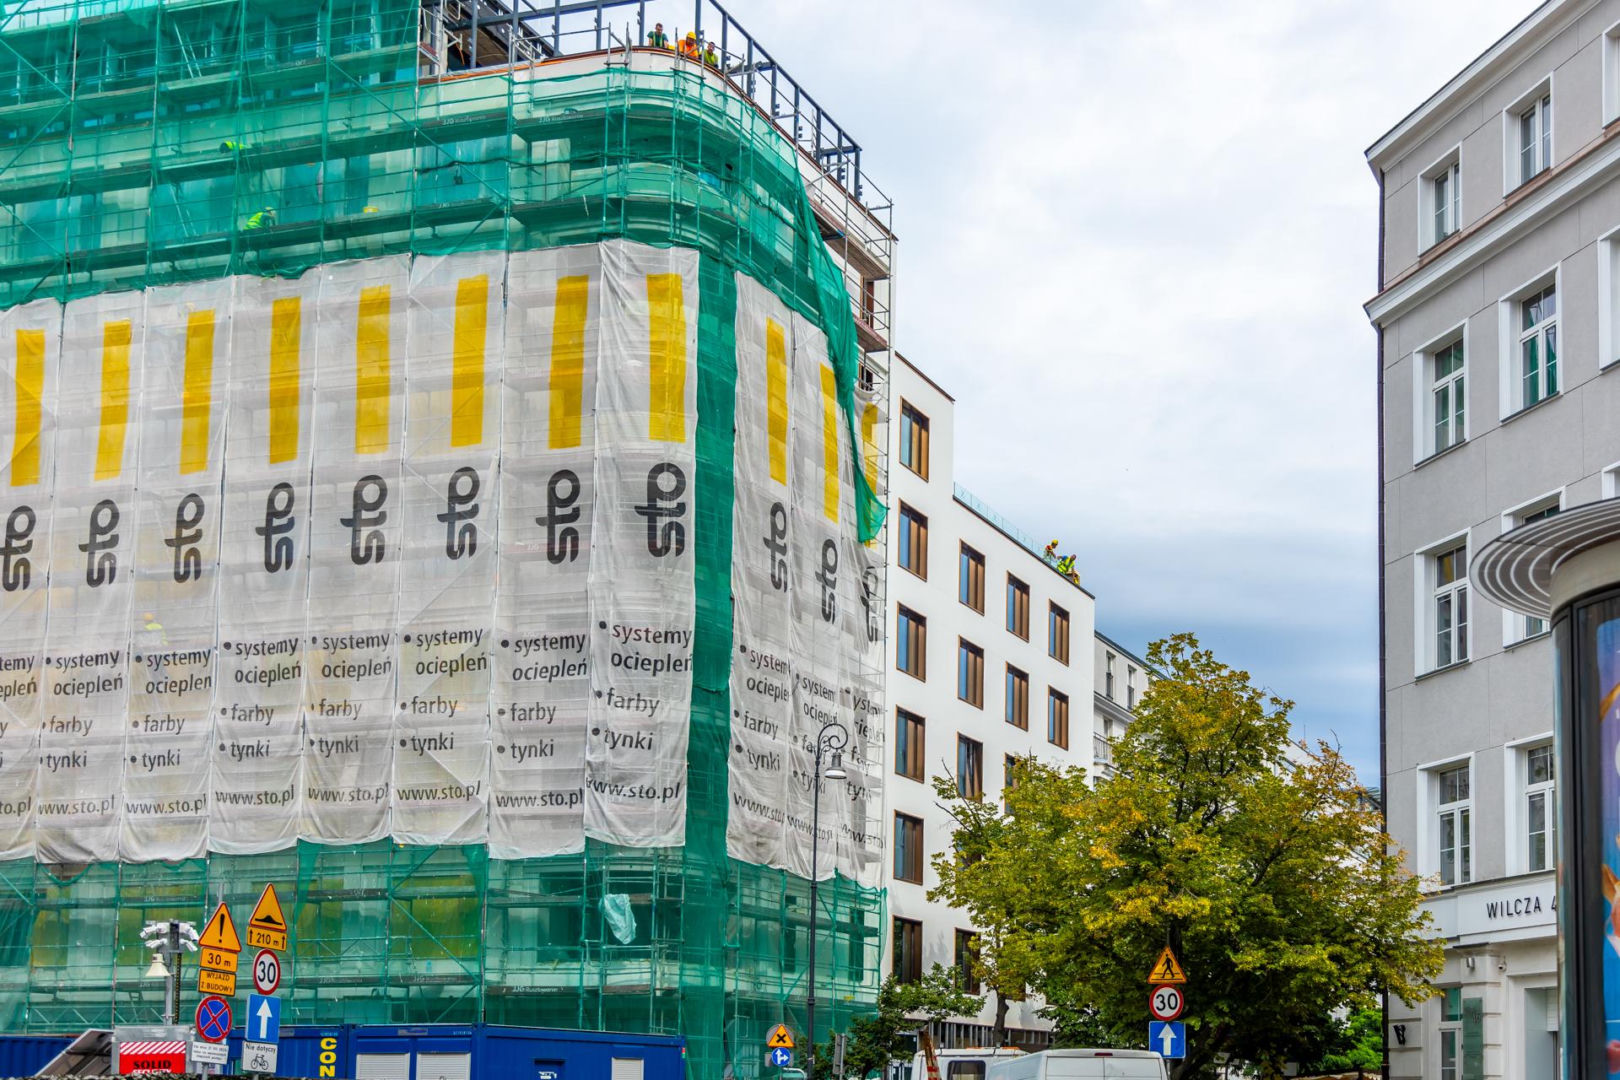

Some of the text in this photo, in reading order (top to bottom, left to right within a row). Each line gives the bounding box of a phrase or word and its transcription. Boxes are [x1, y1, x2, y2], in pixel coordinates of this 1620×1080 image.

[340, 475, 388, 565] sto
[437, 466, 480, 561] sto
[535, 469, 581, 565] sto
[635, 462, 687, 558] sto
[164, 493, 205, 583] sto
[255, 482, 295, 573] sto
[0, 505, 37, 592] sto
[79, 499, 120, 588] sto
[763, 501, 788, 593] sto
[815, 538, 838, 625] sto
[323, 632, 390, 658] systemy
[416, 627, 484, 651] systemy
[514, 632, 587, 657] systemy
[612, 621, 692, 650] systemy
[55, 650, 120, 673] systemy
[235, 636, 298, 663] systemy
[146, 648, 211, 676] systemy
[235, 660, 301, 687] ociepleń
[321, 656, 392, 684] ociepleń
[415, 651, 488, 679] ociepleń
[512, 658, 588, 683] ociepleń
[53, 673, 123, 698] ociepleń
[802, 676, 835, 705] system
[231, 703, 274, 725] farby
[319, 699, 362, 721] farby
[411, 695, 459, 718] farby
[510, 702, 557, 723] farby
[606, 686, 660, 719] farby
[49, 715, 93, 736] farby
[144, 715, 185, 735] farby
[744, 711, 778, 740] farby
[230, 740, 270, 762] tynki
[318, 736, 359, 758] tynki
[411, 732, 455, 756] tynki
[510, 738, 555, 762] tynki
[604, 726, 654, 752] tynki
[47, 750, 87, 773] tynki
[141, 750, 181, 773] tynki
[747, 748, 780, 771] tynki
[126, 793, 207, 815] www.sto.pl
[215, 784, 295, 807] www.sto.pl
[308, 782, 389, 803] www.sto.pl
[396, 780, 482, 805] www.sto.pl
[496, 788, 584, 811] www.sto.pl
[1486, 896, 1542, 919] WILCZA
[256, 932, 271, 945] 210
[207, 952, 222, 966] 30
[257, 960, 276, 984] 30
[1156, 992, 1178, 1012] 30
[245, 1043, 276, 1054] Nie dotyczy
[133, 1060, 172, 1069] SOLID
